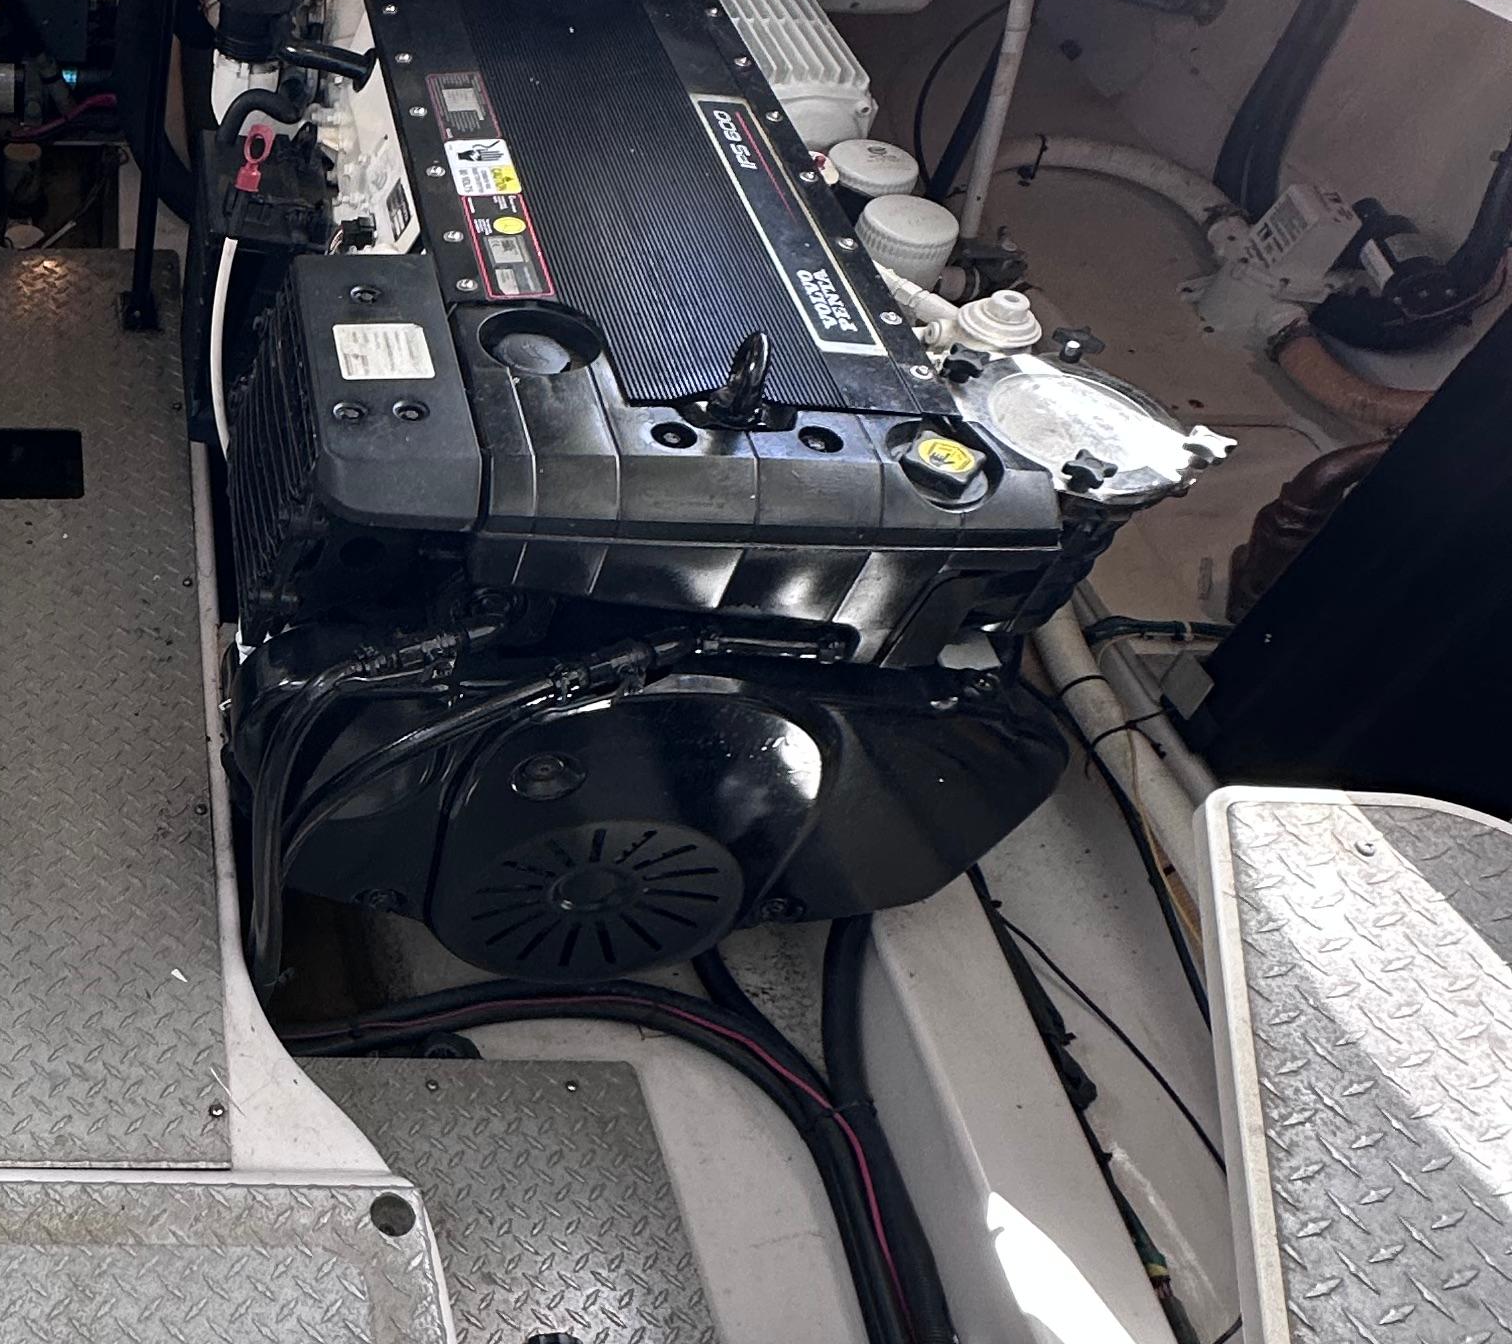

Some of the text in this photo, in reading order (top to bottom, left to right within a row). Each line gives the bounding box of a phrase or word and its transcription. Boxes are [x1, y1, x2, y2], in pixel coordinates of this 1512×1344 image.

[713, 109, 758, 171] IPS 600
[796, 269, 838, 330] VOLVO
[812, 268, 859, 333] PENTA
